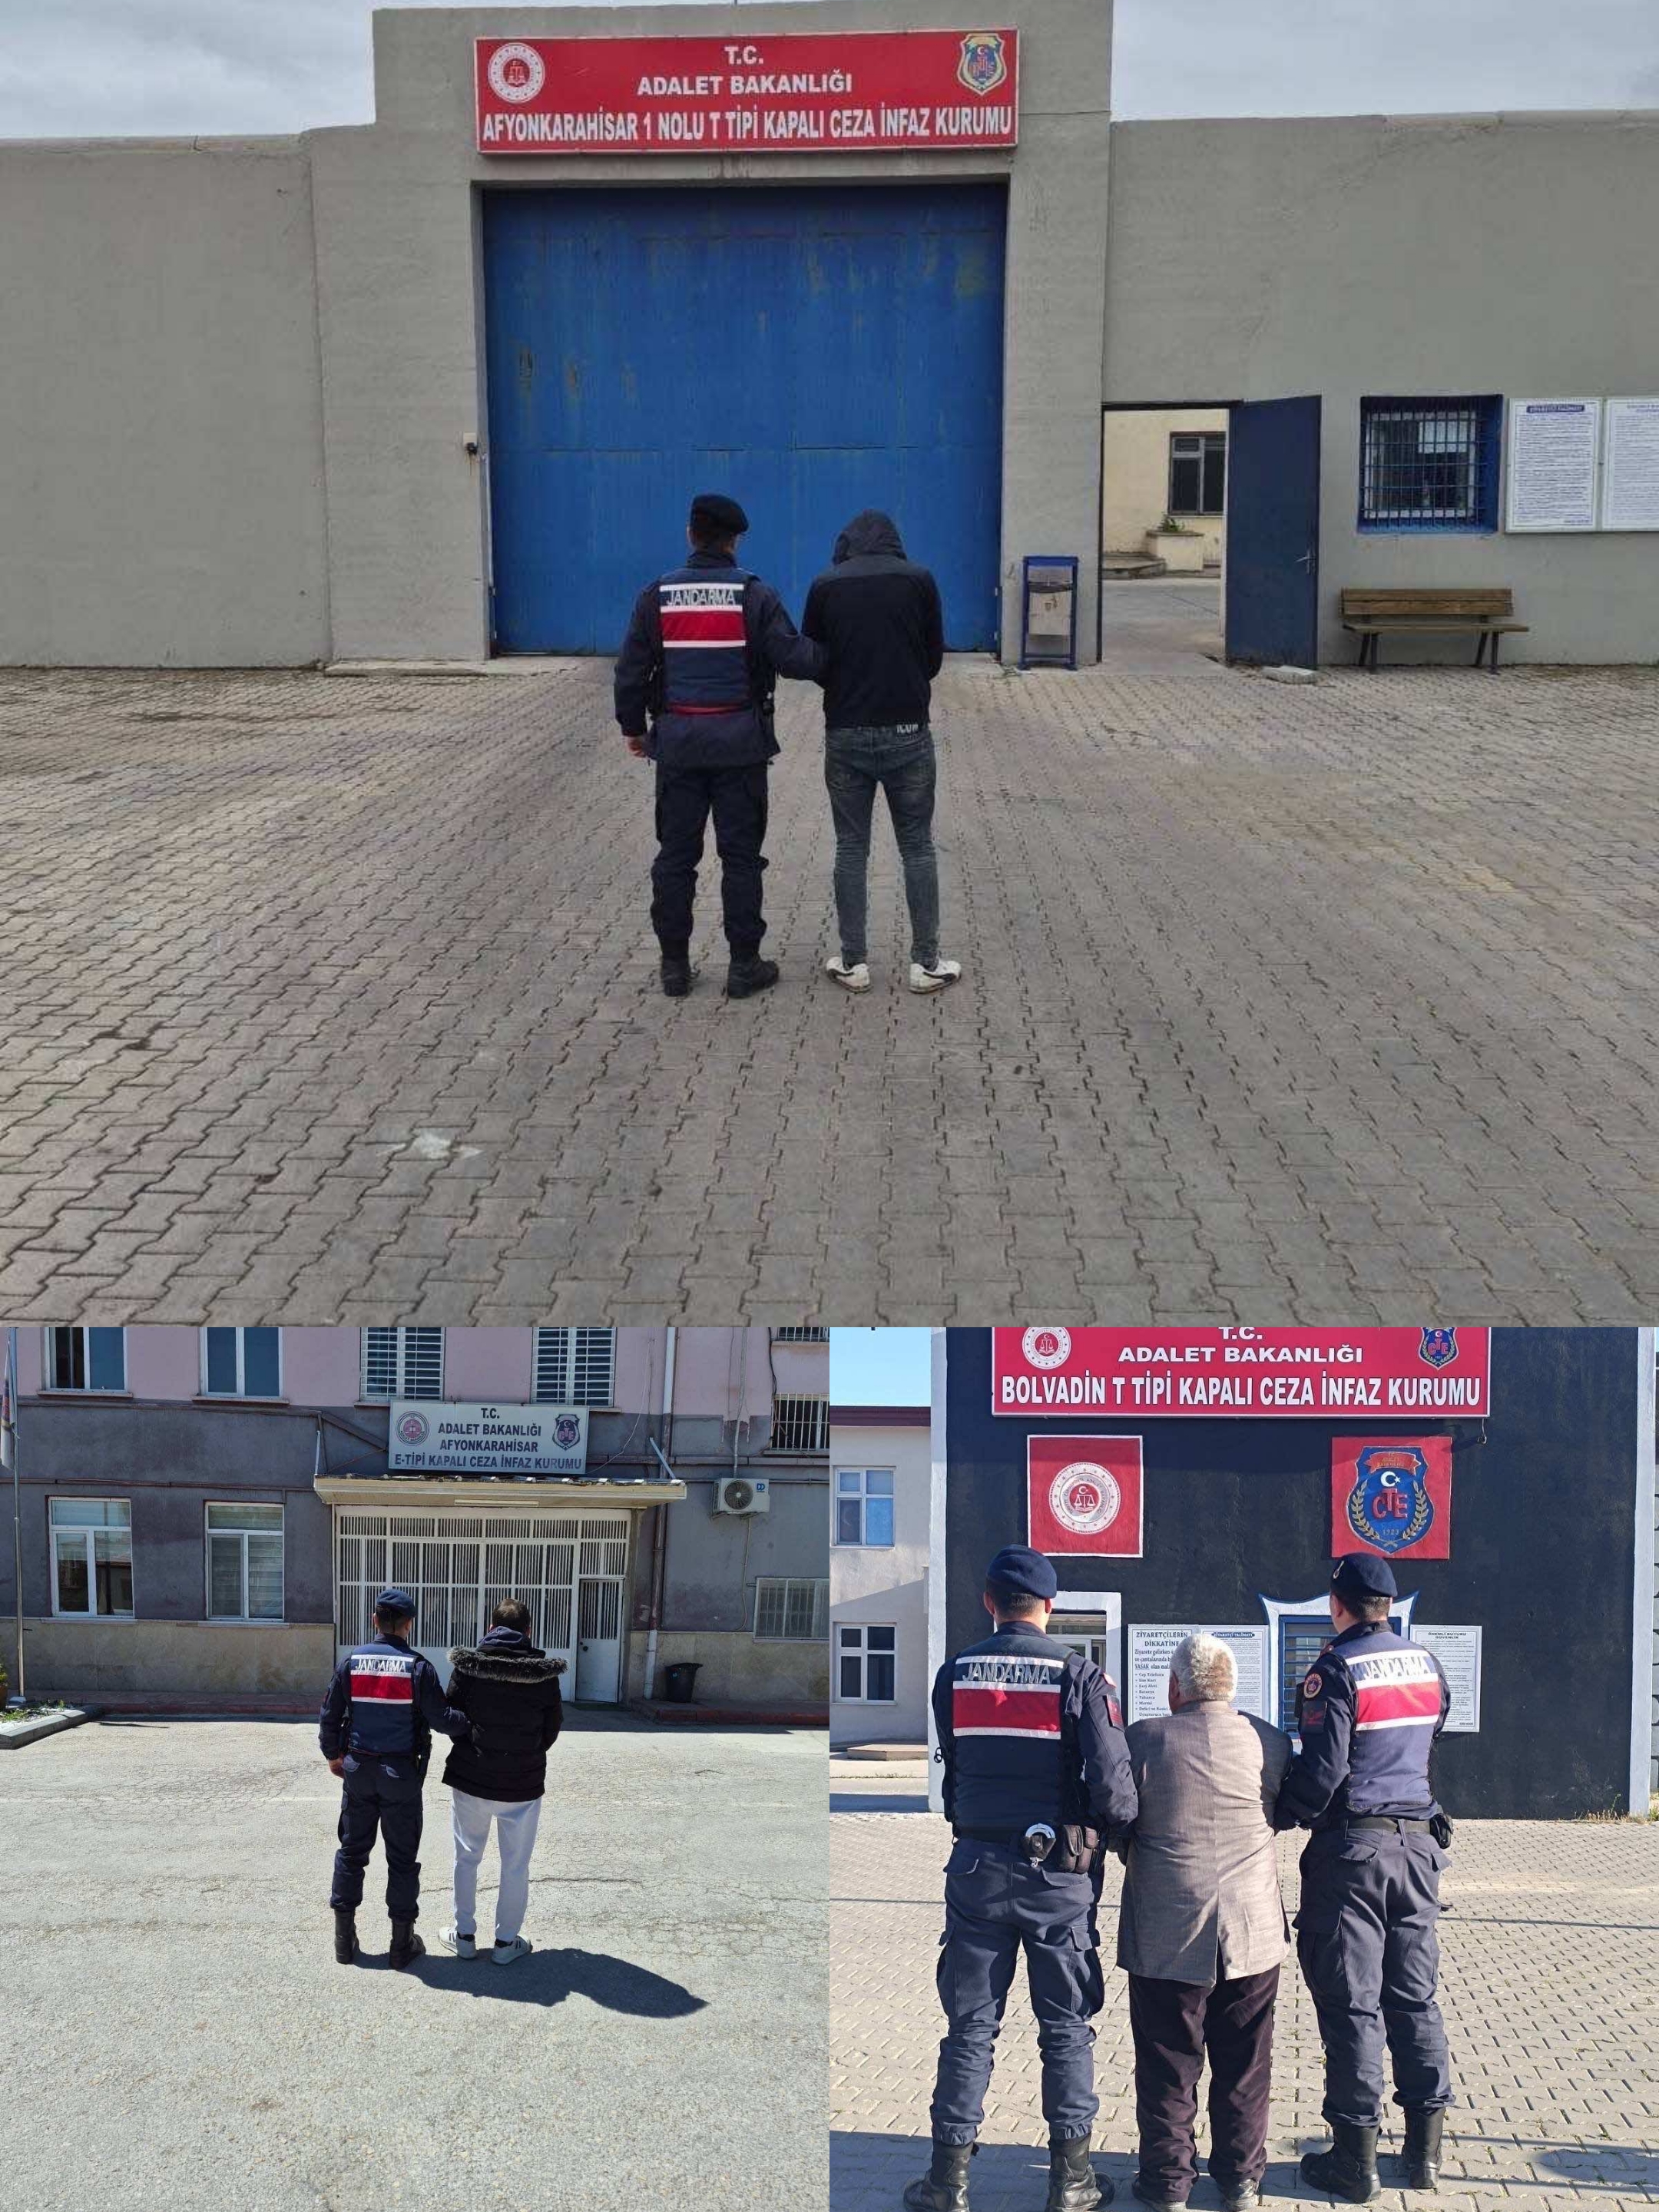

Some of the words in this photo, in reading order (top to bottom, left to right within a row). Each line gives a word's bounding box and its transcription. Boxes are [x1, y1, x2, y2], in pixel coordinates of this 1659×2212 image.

[724, 45, 764, 65] T.C.
[637, 75, 724, 95] ADALET
[730, 68, 853, 94] BAKANLIĞI
[482, 105, 638, 141] AFYONKARAHİSAR
[643, 112, 651, 140] 1
[658, 111, 704, 141] NOLU
[709, 111, 720, 140] T
[725, 104, 758, 139] TİPİ
[763, 110, 824, 139] KAPALI
[830, 108, 876, 138] CEZA
[880, 102, 930, 137] İNFAZ
[935, 105, 1012, 135] KURUMU
[665, 589, 736, 606] JANDARMA
[1219, 1327, 1263, 1339] T.C.
[1118, 1347, 1217, 1362] ADALET
[1224, 1344, 1363, 1363] BAKANLIĞI
[1002, 1369, 1106, 1404] BOLVADİN
[1111, 1376, 1126, 1405] T
[1131, 1369, 1171, 1405] TİPİ
[1179, 1377, 1253, 1405] KAPALI
[1260, 1376, 1315, 1406] CEZA
[1320, 1370, 1382, 1406] İNFAZ
[1388, 1378, 1481, 1406] KURUMU
[481, 1408, 500, 1419] T.C.
[438, 1423, 480, 1435] ADALET
[483, 1423, 541, 1436] BAKANLIĞI
[440, 1439, 538, 1452] AFYONKARAHİSAR
[395, 1452, 426, 1465] E-TİPİ
[429, 1455, 467, 1467] KAPALI
[469, 1455, 498, 1467] CEZA
[501, 1454, 531, 1468] İNFAZ
[535, 1458, 582, 1469] KURUMU
[1372, 1488, 1408, 1518] CTE
[1136, 1631, 1188, 1639] ZİYARETÇİLERİN
[356, 1658, 406, 1673] JANDARMA
[962, 1663, 1051, 1684] JANDARMA
[1363, 1656, 1432, 1680] JANDARMA
